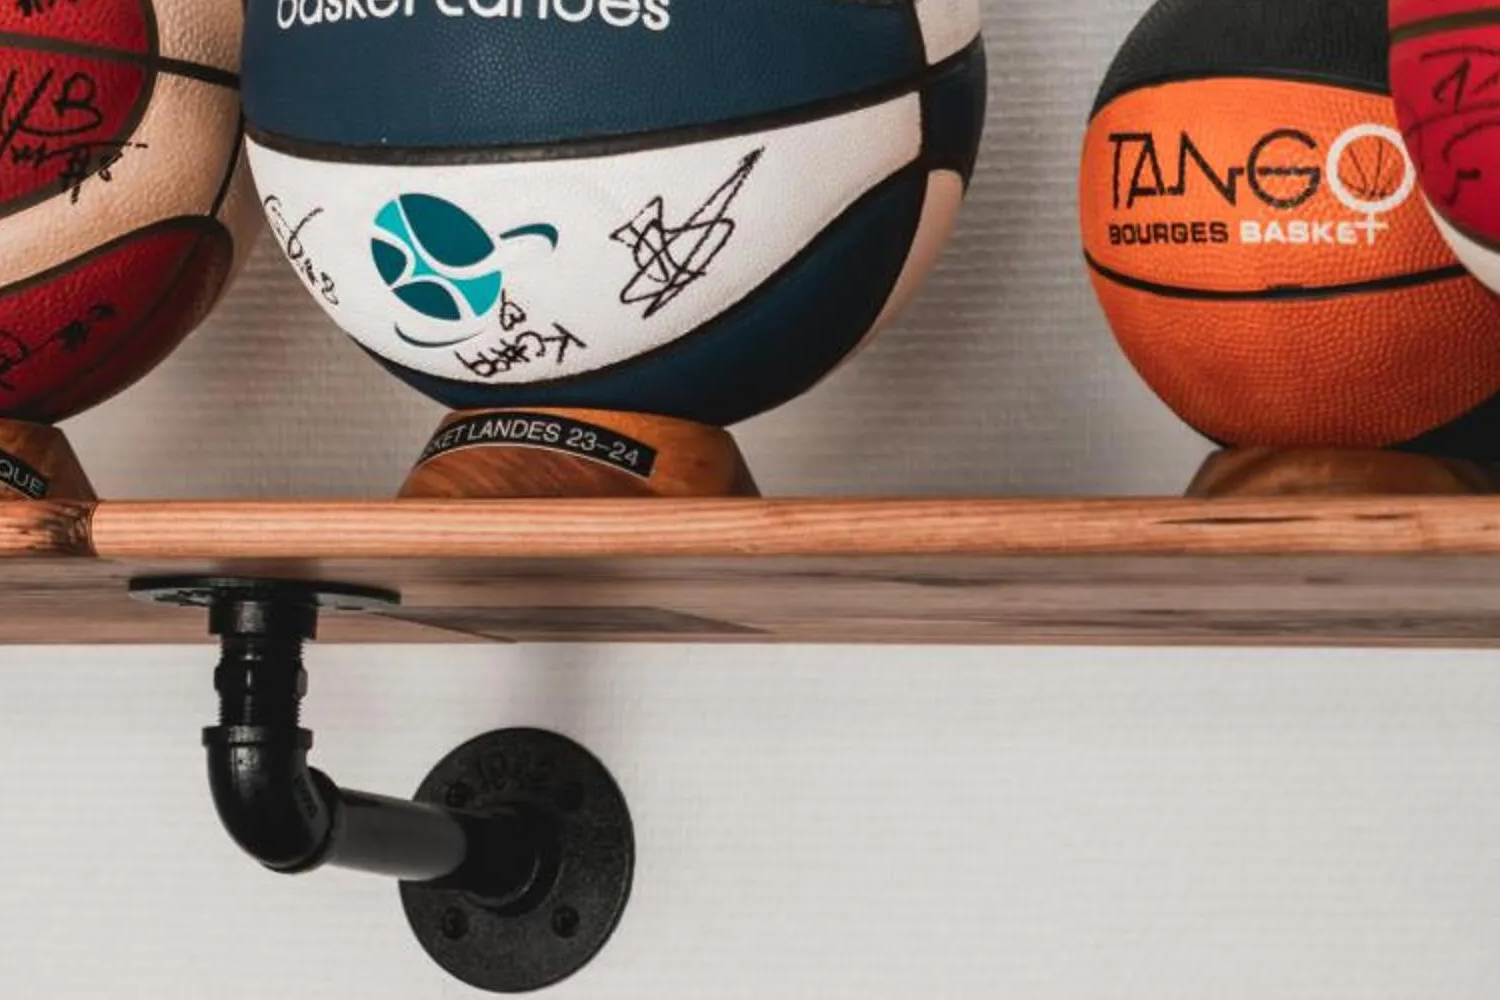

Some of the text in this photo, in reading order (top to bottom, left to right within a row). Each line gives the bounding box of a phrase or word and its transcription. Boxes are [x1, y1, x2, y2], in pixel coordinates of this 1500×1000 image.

[1108, 123, 1417, 213] TANGO
[1108, 212, 1389, 246] BOURGES BASKET
[467, 419, 561, 443] LANDES
[566, 428, 639, 467] 23-24
